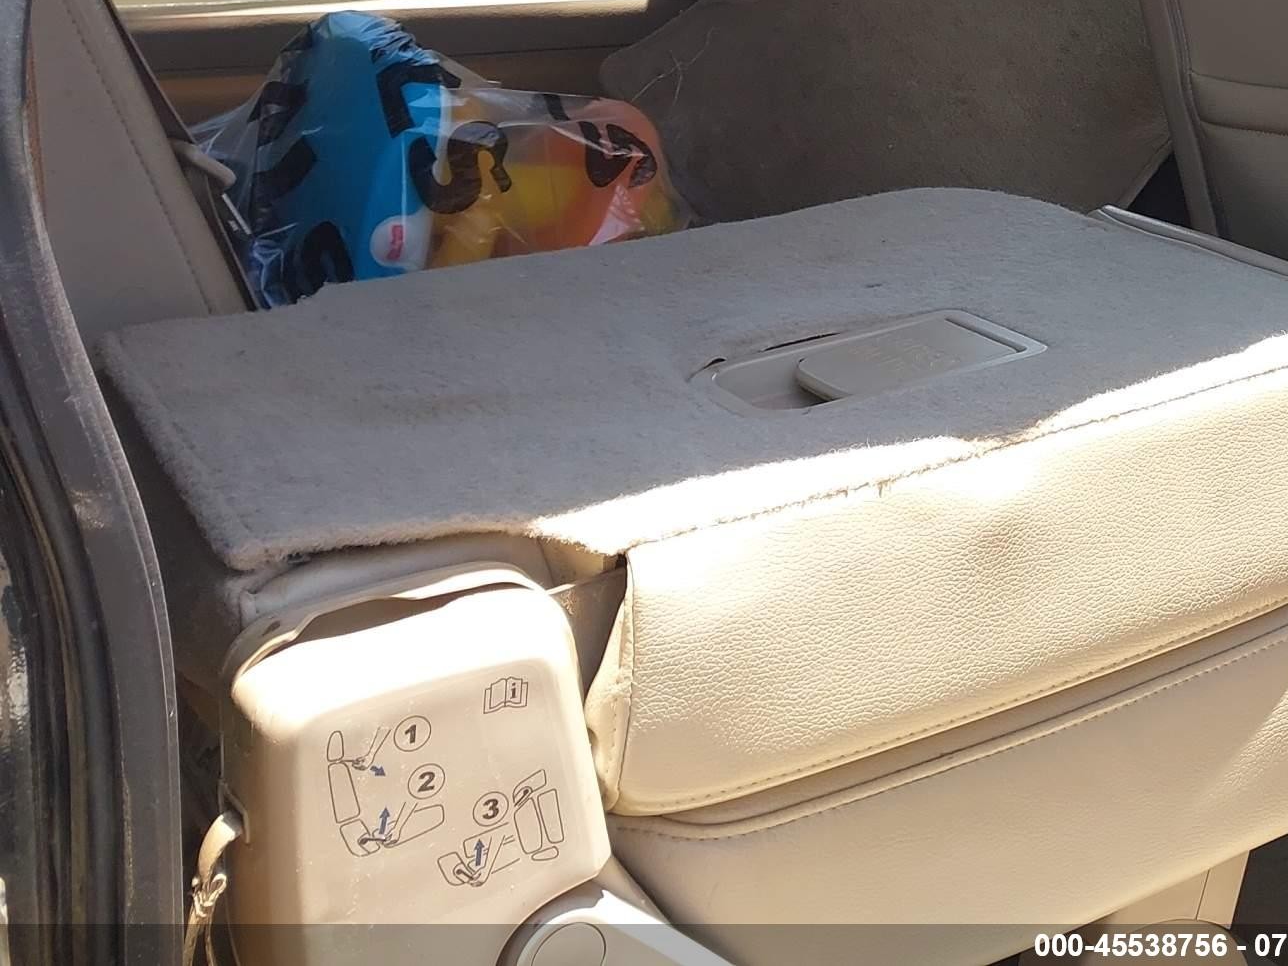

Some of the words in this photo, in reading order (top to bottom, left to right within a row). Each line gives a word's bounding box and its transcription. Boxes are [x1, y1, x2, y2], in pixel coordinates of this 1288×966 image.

[405, 725, 417, 744] 1
[418, 772, 435, 792] 2
[483, 799, 500, 820] 3
